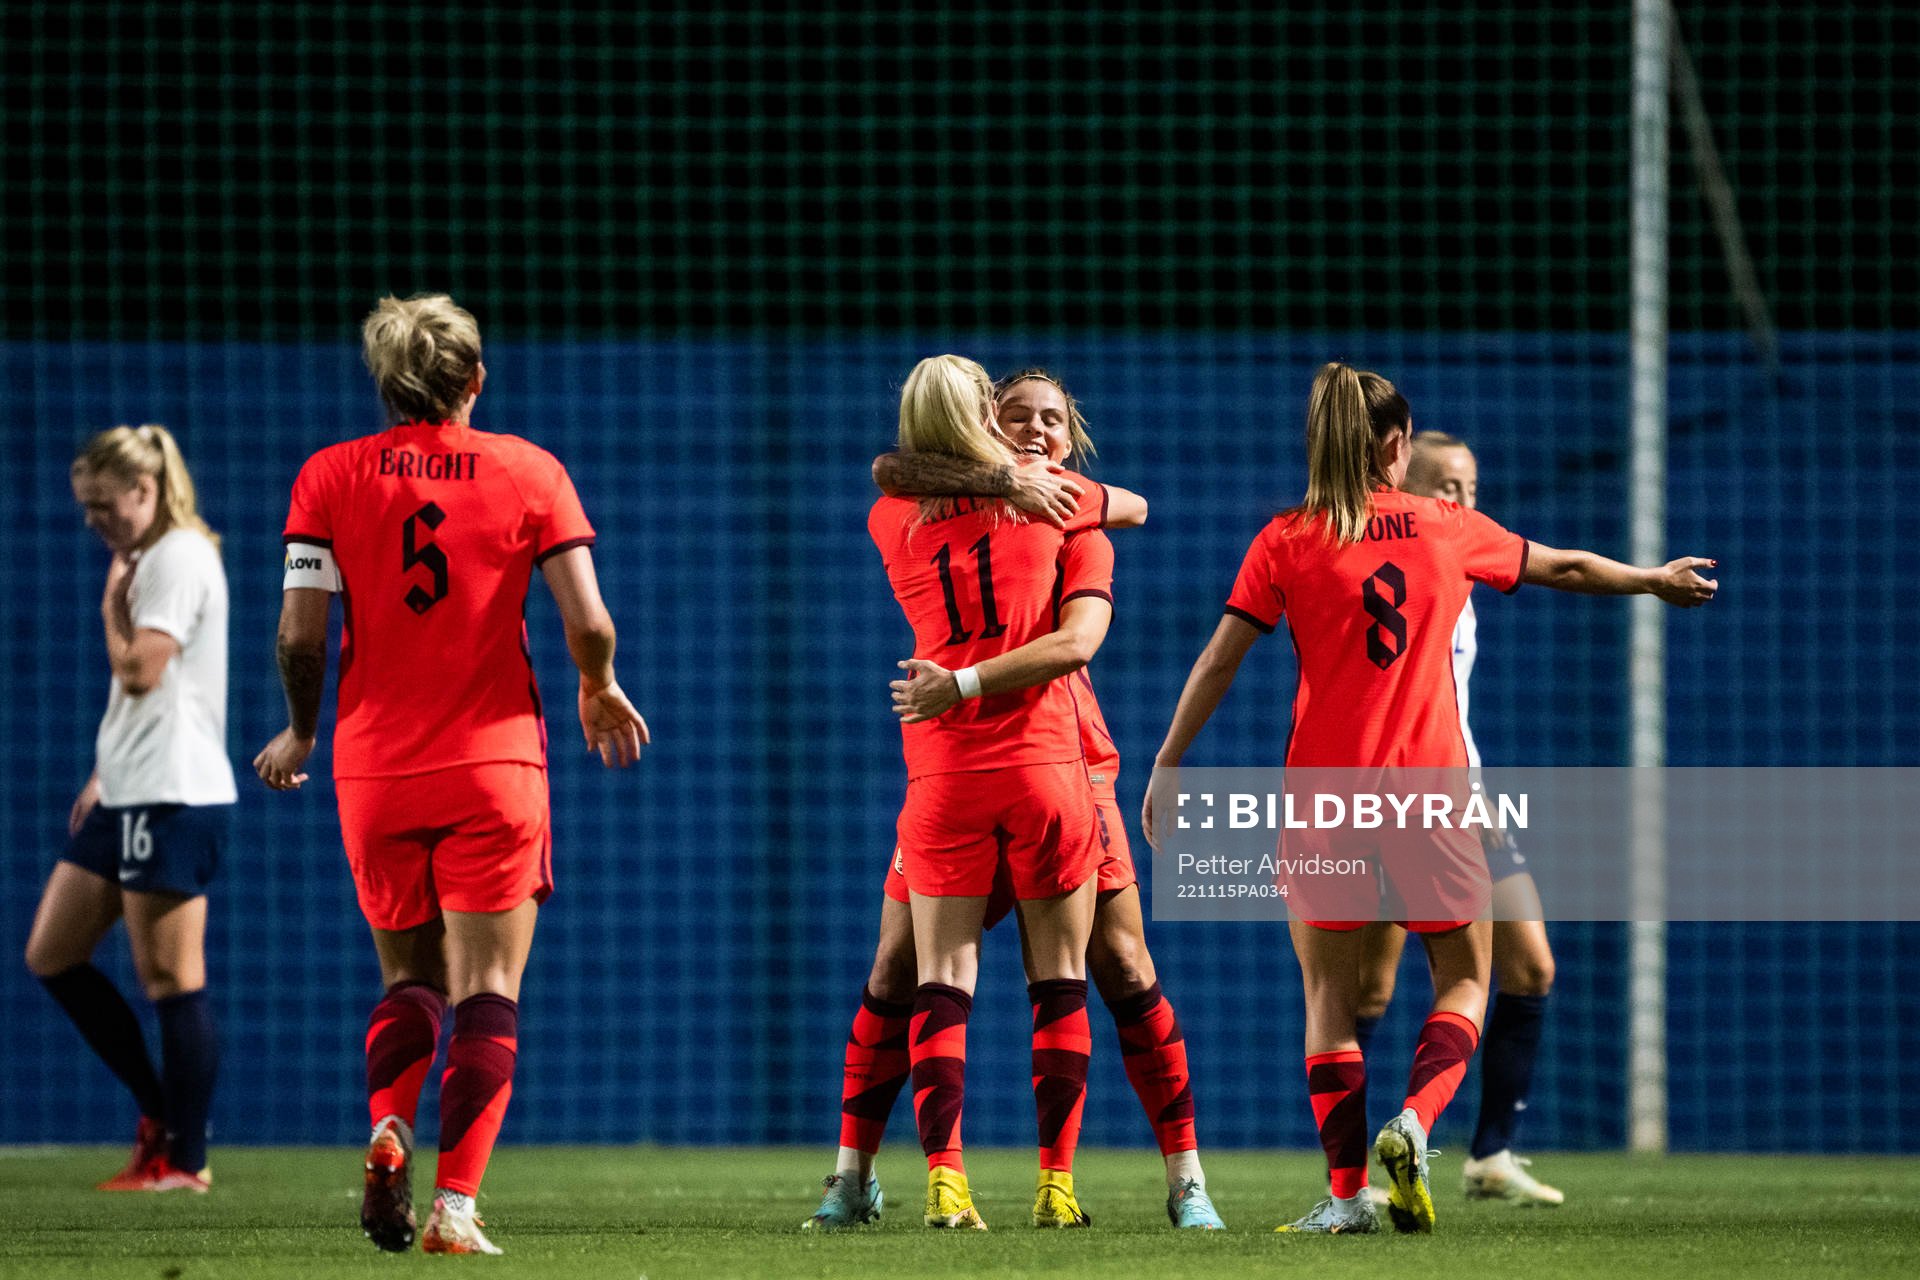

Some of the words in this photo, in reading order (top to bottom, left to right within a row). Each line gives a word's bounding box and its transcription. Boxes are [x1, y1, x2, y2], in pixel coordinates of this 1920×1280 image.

[380, 448, 480, 480] BRIGHT
[1353, 512, 1418, 543] ONE
[289, 557, 322, 570] LOVE
[402, 501, 449, 616] 5
[930, 532, 1008, 646] 11
[1362, 561, 1407, 671] 8
[122, 811, 154, 861] 16
